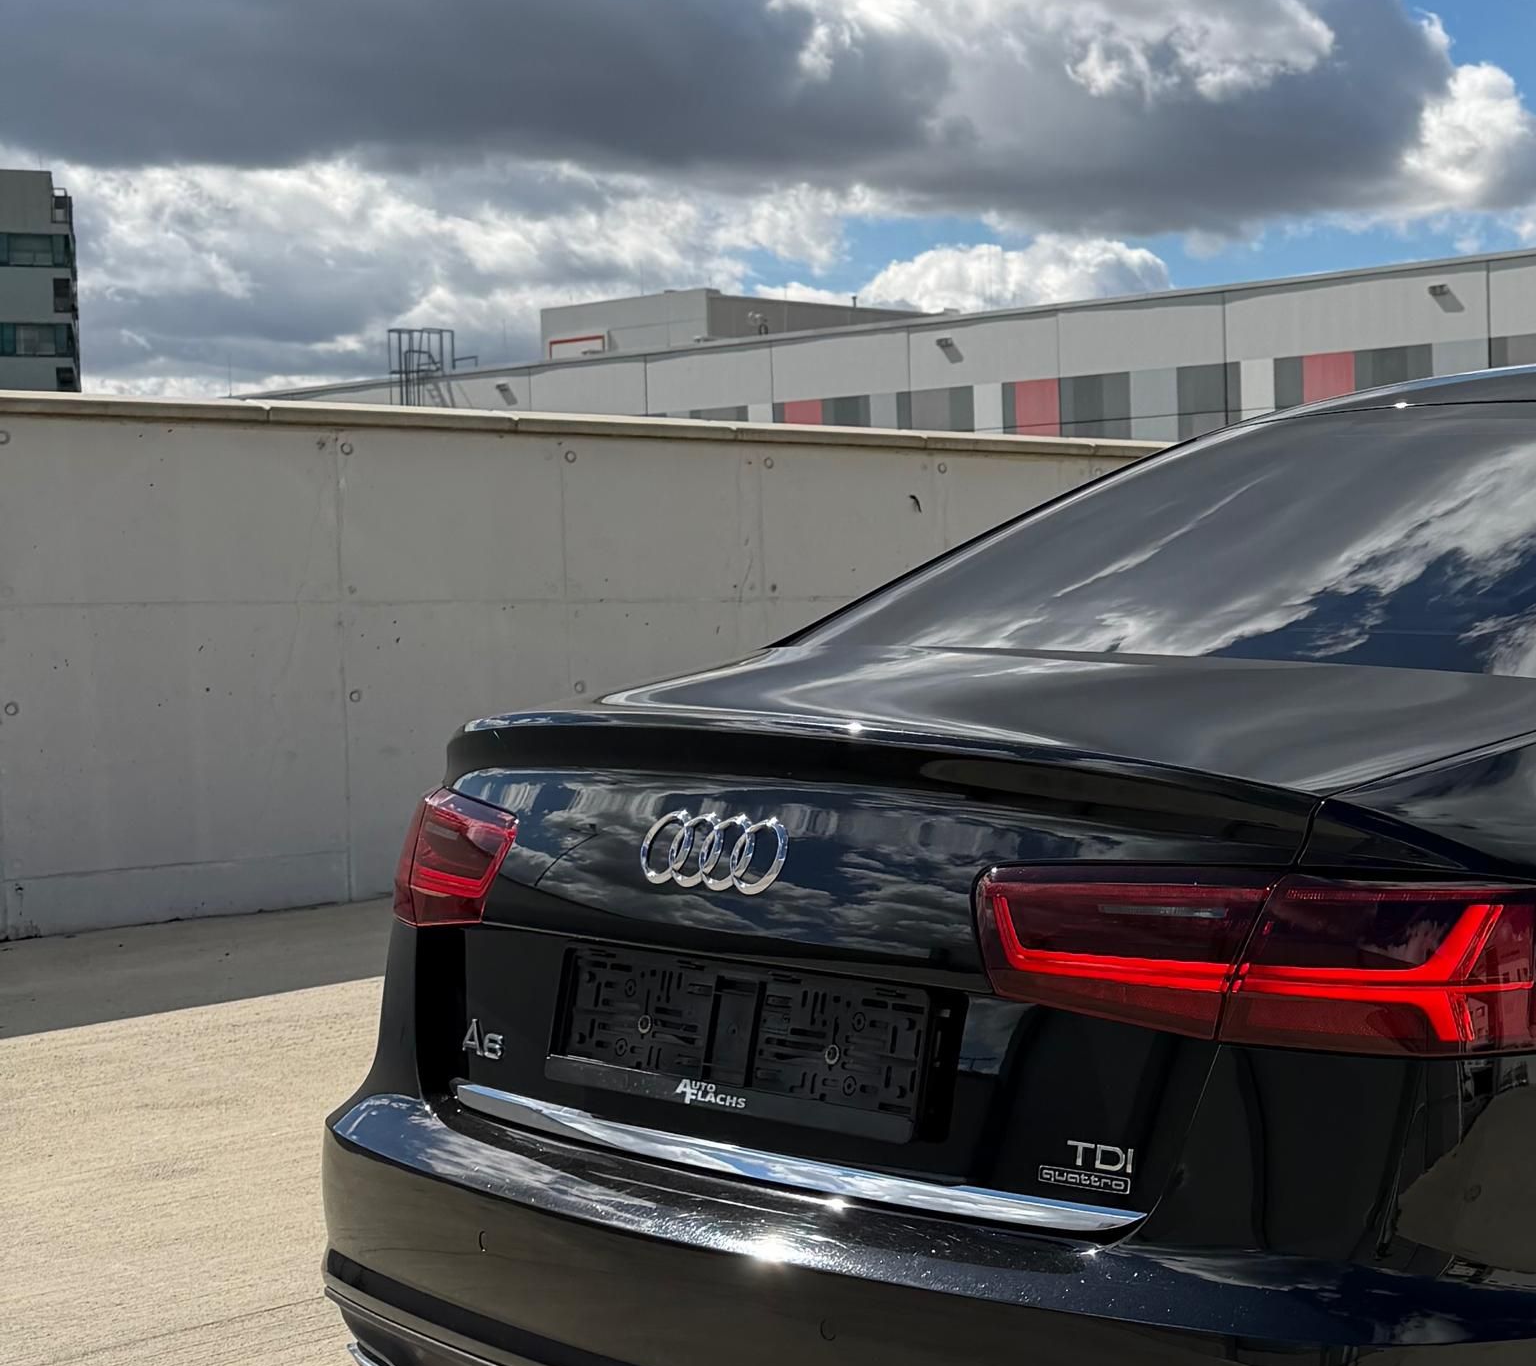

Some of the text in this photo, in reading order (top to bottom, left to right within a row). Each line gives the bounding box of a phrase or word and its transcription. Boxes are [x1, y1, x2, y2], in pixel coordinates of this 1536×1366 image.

[462, 1018, 503, 1059] A6
[674, 1078, 717, 1093] AUTO
[684, 1089, 747, 1109] FLACHS
[1066, 1140, 1134, 1173] TDI
[1041, 1169, 1125, 1190] quattro
